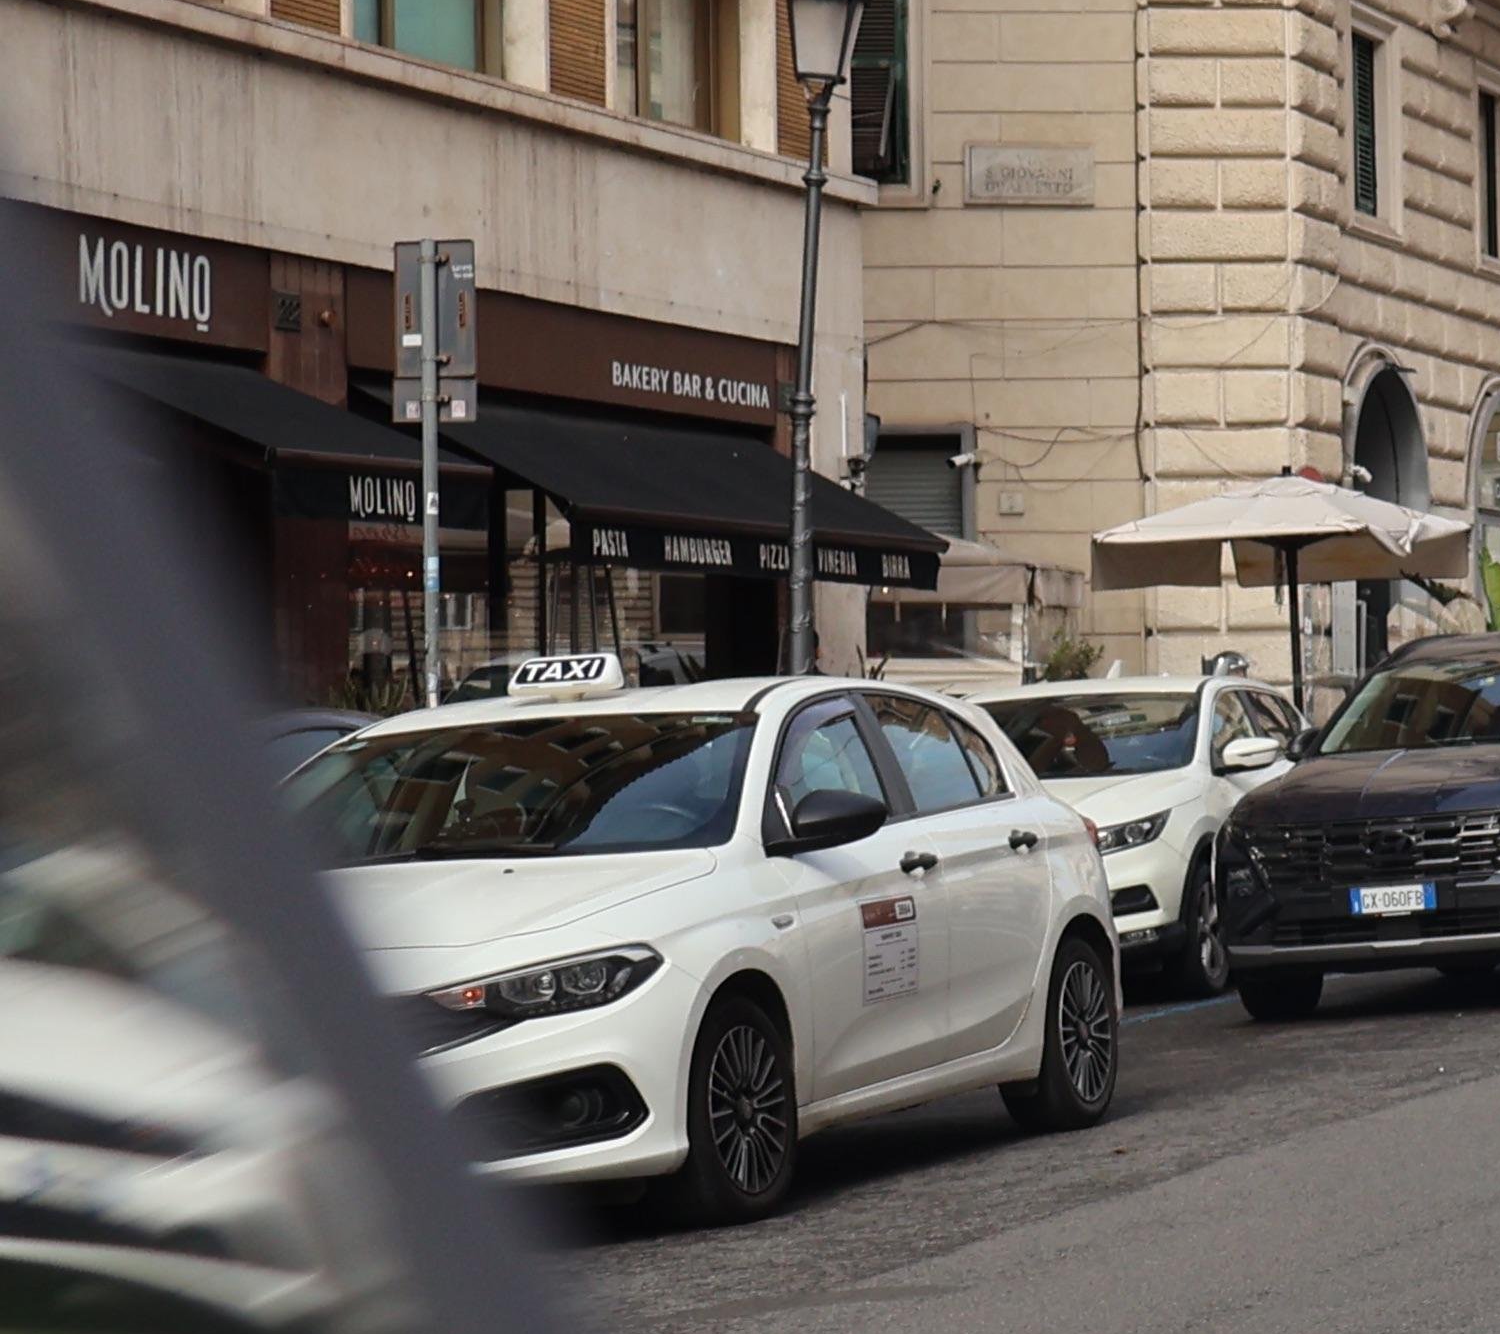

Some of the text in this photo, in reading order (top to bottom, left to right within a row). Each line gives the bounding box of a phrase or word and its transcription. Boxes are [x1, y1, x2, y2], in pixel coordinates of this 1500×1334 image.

[78, 233, 210, 333] MOLINO
[611, 361, 770, 409] BAKERY BAR & CUCINA
[349, 475, 417, 523] MOLINO
[592, 528, 629, 558] PASTA
[664, 536, 733, 566] HAMBURGER
[818, 547, 857, 575] VINERIA
[881, 553, 911, 580] BIRRA
[525, 658, 601, 682] TAXI
